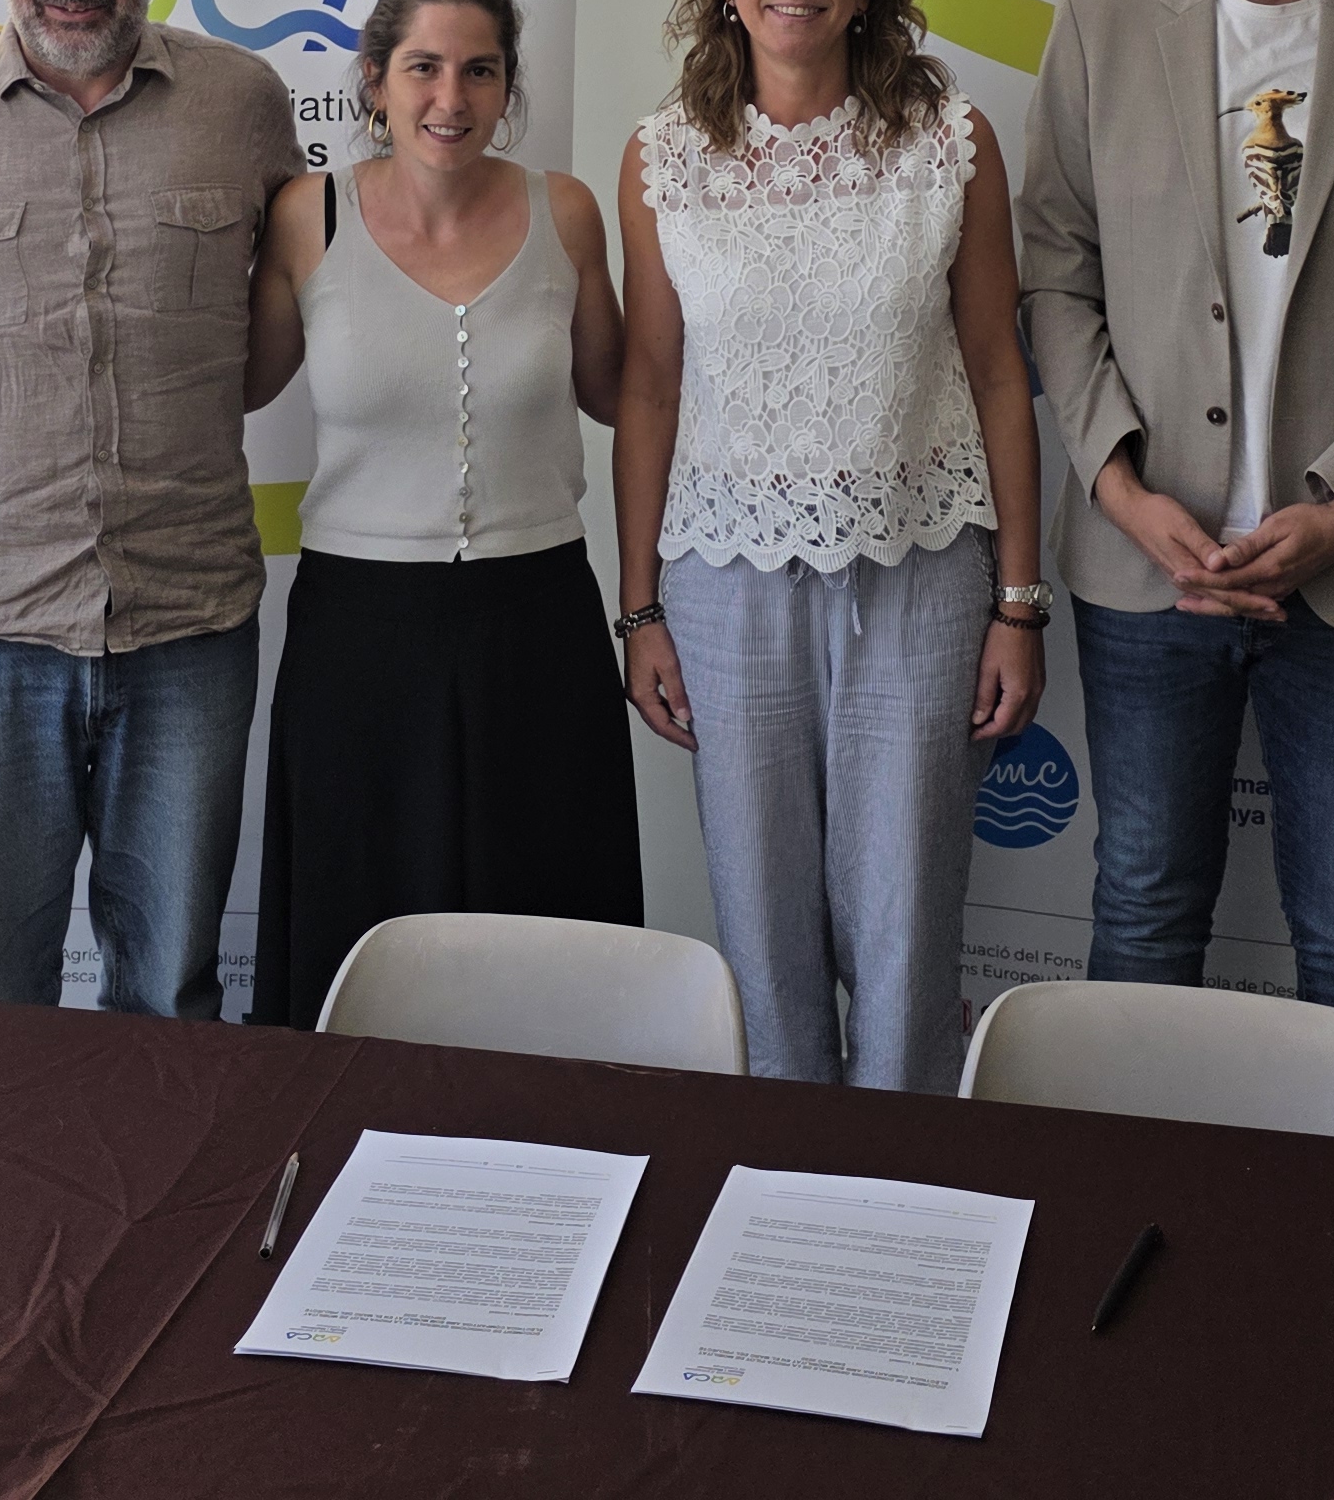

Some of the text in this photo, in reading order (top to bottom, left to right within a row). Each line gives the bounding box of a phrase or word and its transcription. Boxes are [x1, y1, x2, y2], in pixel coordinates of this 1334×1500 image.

[1014, 948, 1039, 963] del
[1044, 951, 1084, 970] Fons
[1235, 978, 1258, 993] de
[1262, 981, 1298, 998] Des
